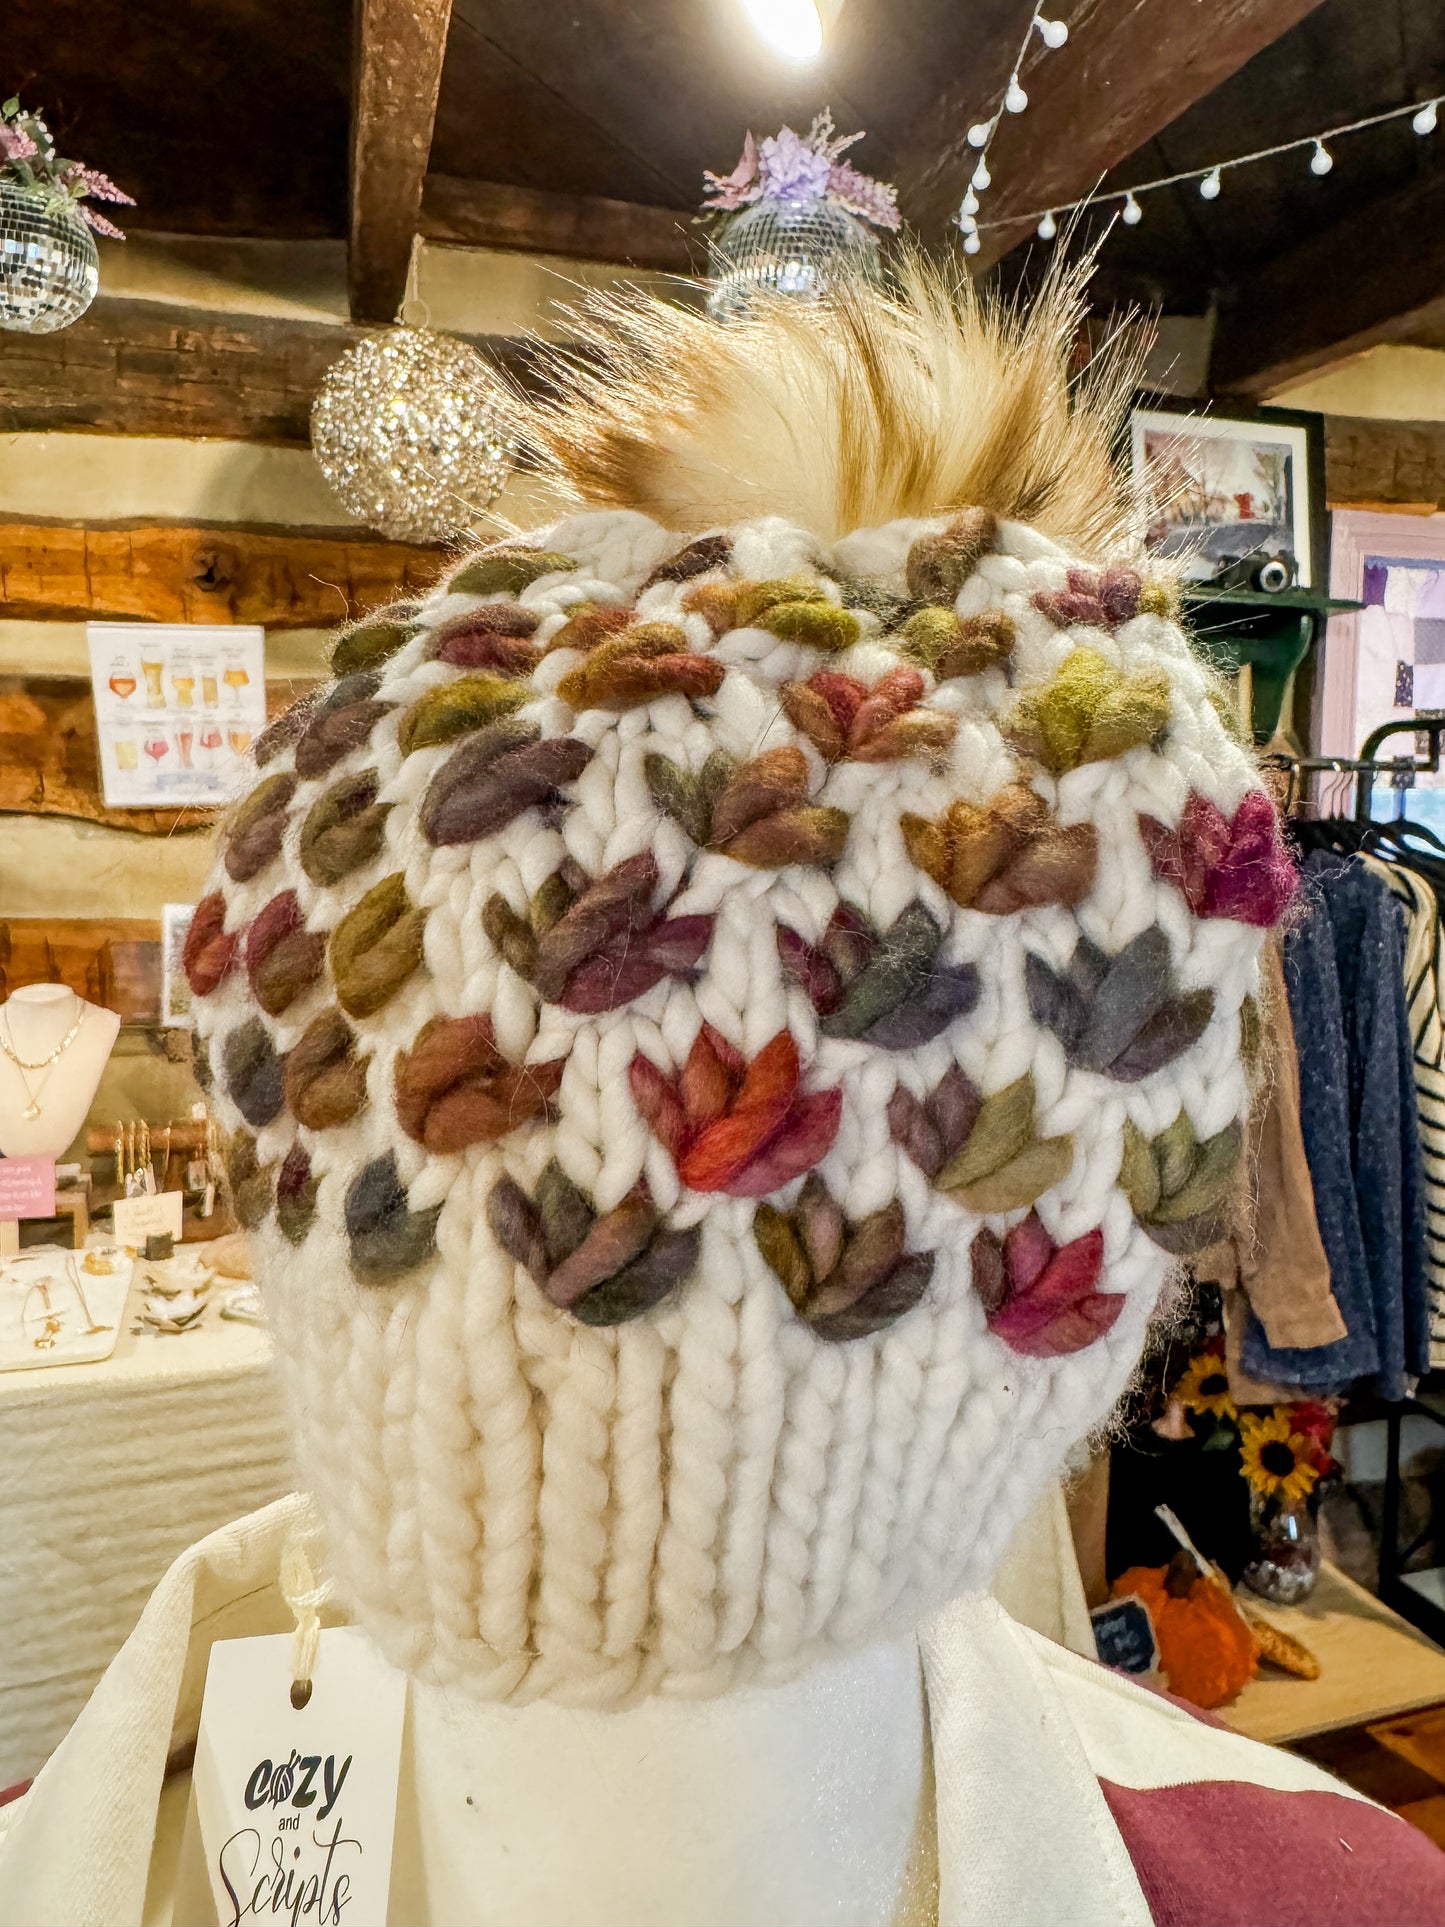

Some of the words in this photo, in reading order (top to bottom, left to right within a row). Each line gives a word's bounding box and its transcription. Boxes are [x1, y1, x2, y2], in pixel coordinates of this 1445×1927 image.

[244, 1749, 353, 1820] cozy
[278, 1813, 300, 1831] and
[219, 1818, 363, 1927] Scripts
